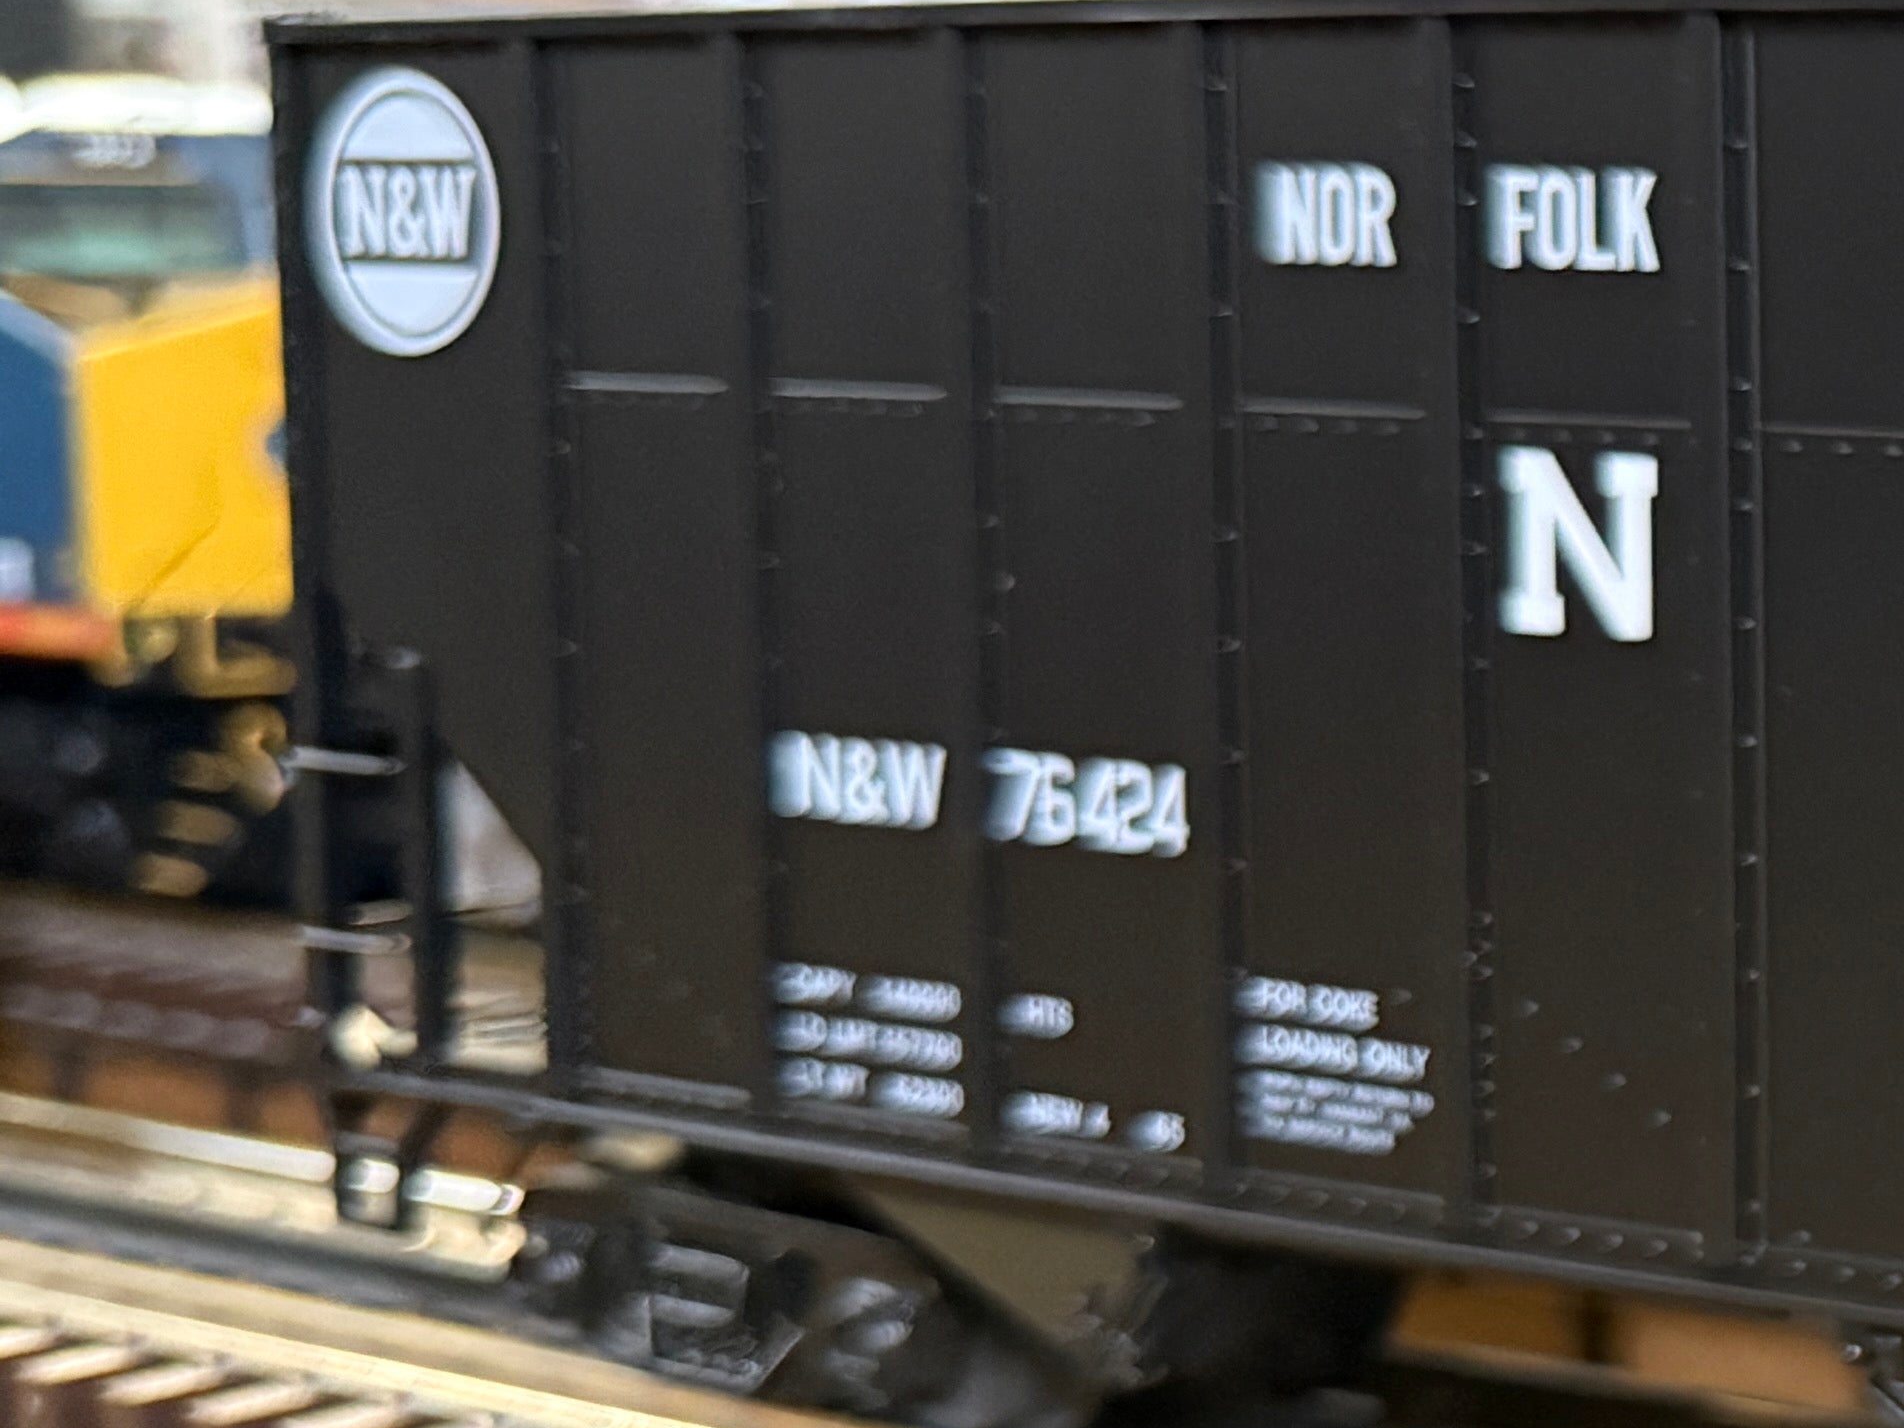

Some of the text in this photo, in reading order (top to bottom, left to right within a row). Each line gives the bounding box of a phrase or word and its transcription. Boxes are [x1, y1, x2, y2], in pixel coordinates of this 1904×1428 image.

[340, 162, 477, 261] N&W
[1258, 162, 1397, 268] NOR
[1487, 166, 1661, 273] FOLK
[1499, 445, 1659, 642] N
[774, 730, 1191, 857] N&W 76424
[1240, 1025, 1431, 1083] LOADING ONLY
